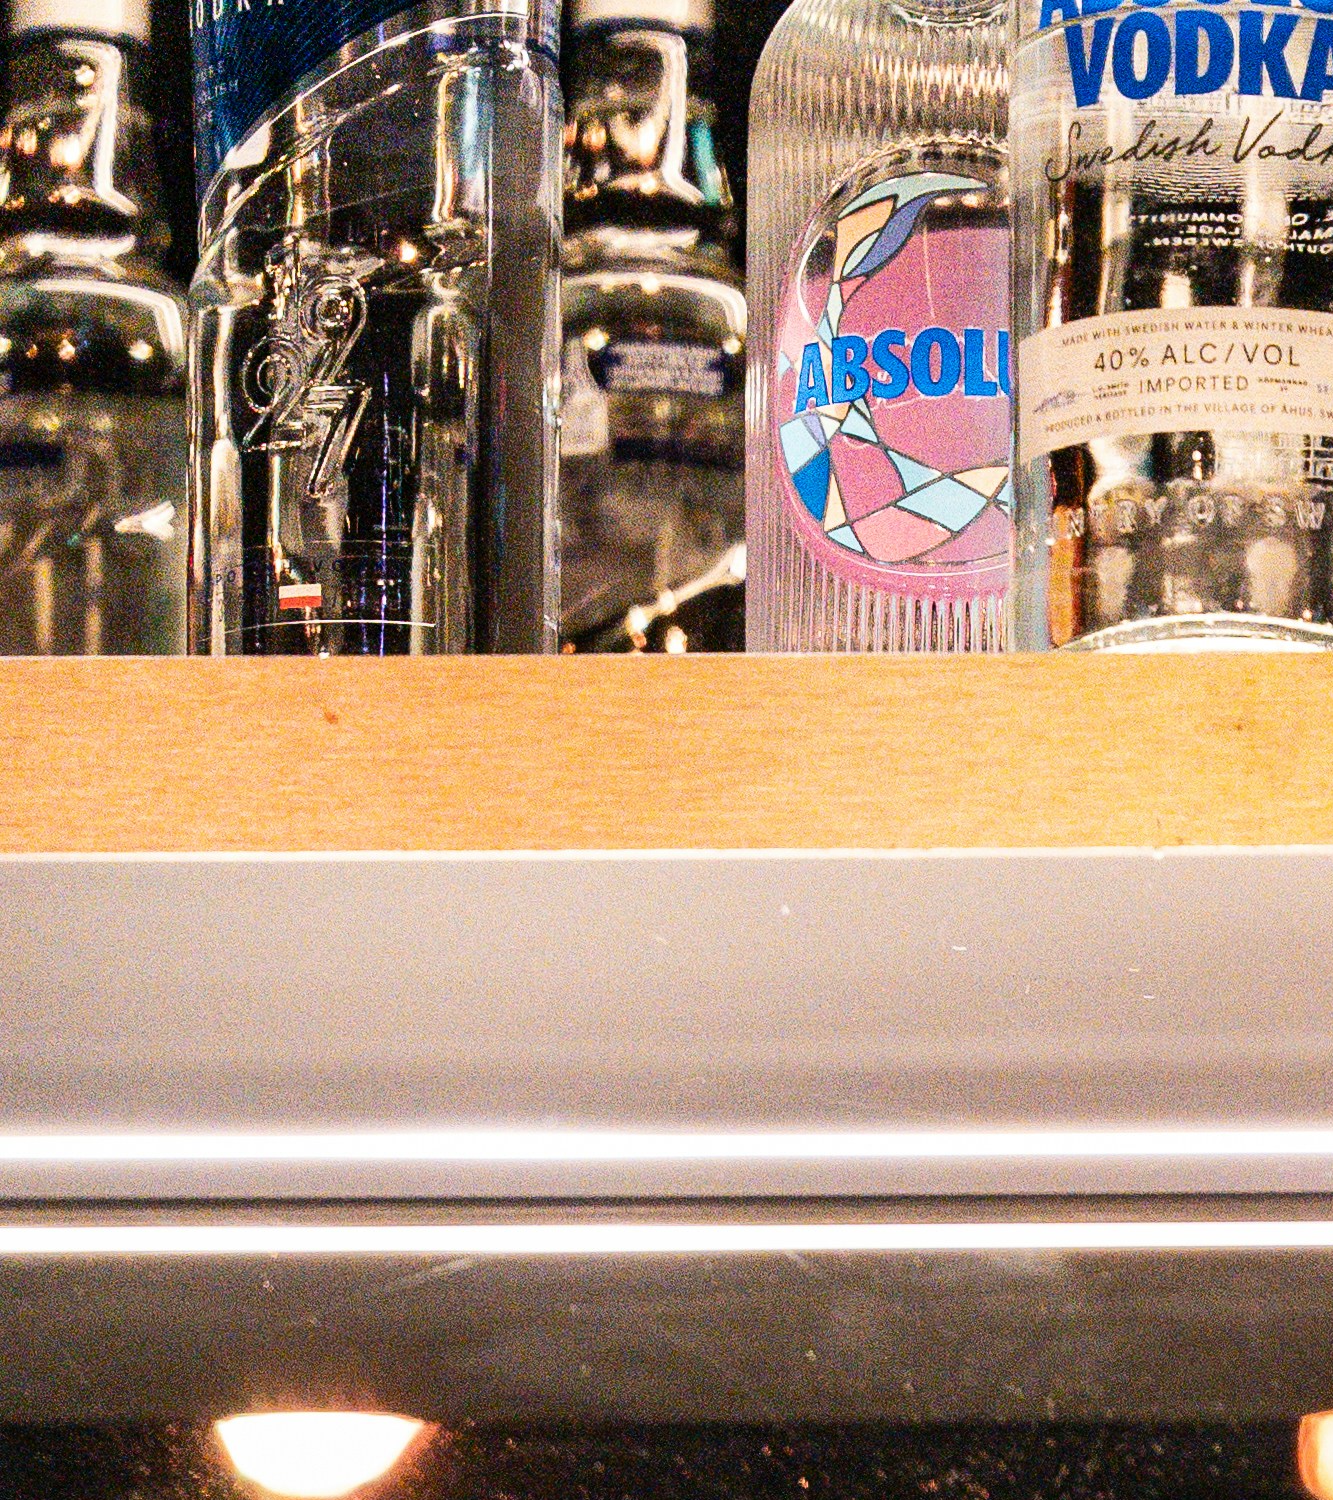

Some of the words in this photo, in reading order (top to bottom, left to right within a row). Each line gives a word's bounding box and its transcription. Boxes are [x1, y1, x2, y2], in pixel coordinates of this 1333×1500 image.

[1045, 118, 1222, 182] Swedish
[1093, 347, 1151, 374] 40%
[1161, 342, 1301, 367] ALC/VOL
[1138, 374, 1250, 395] IMPORTED
